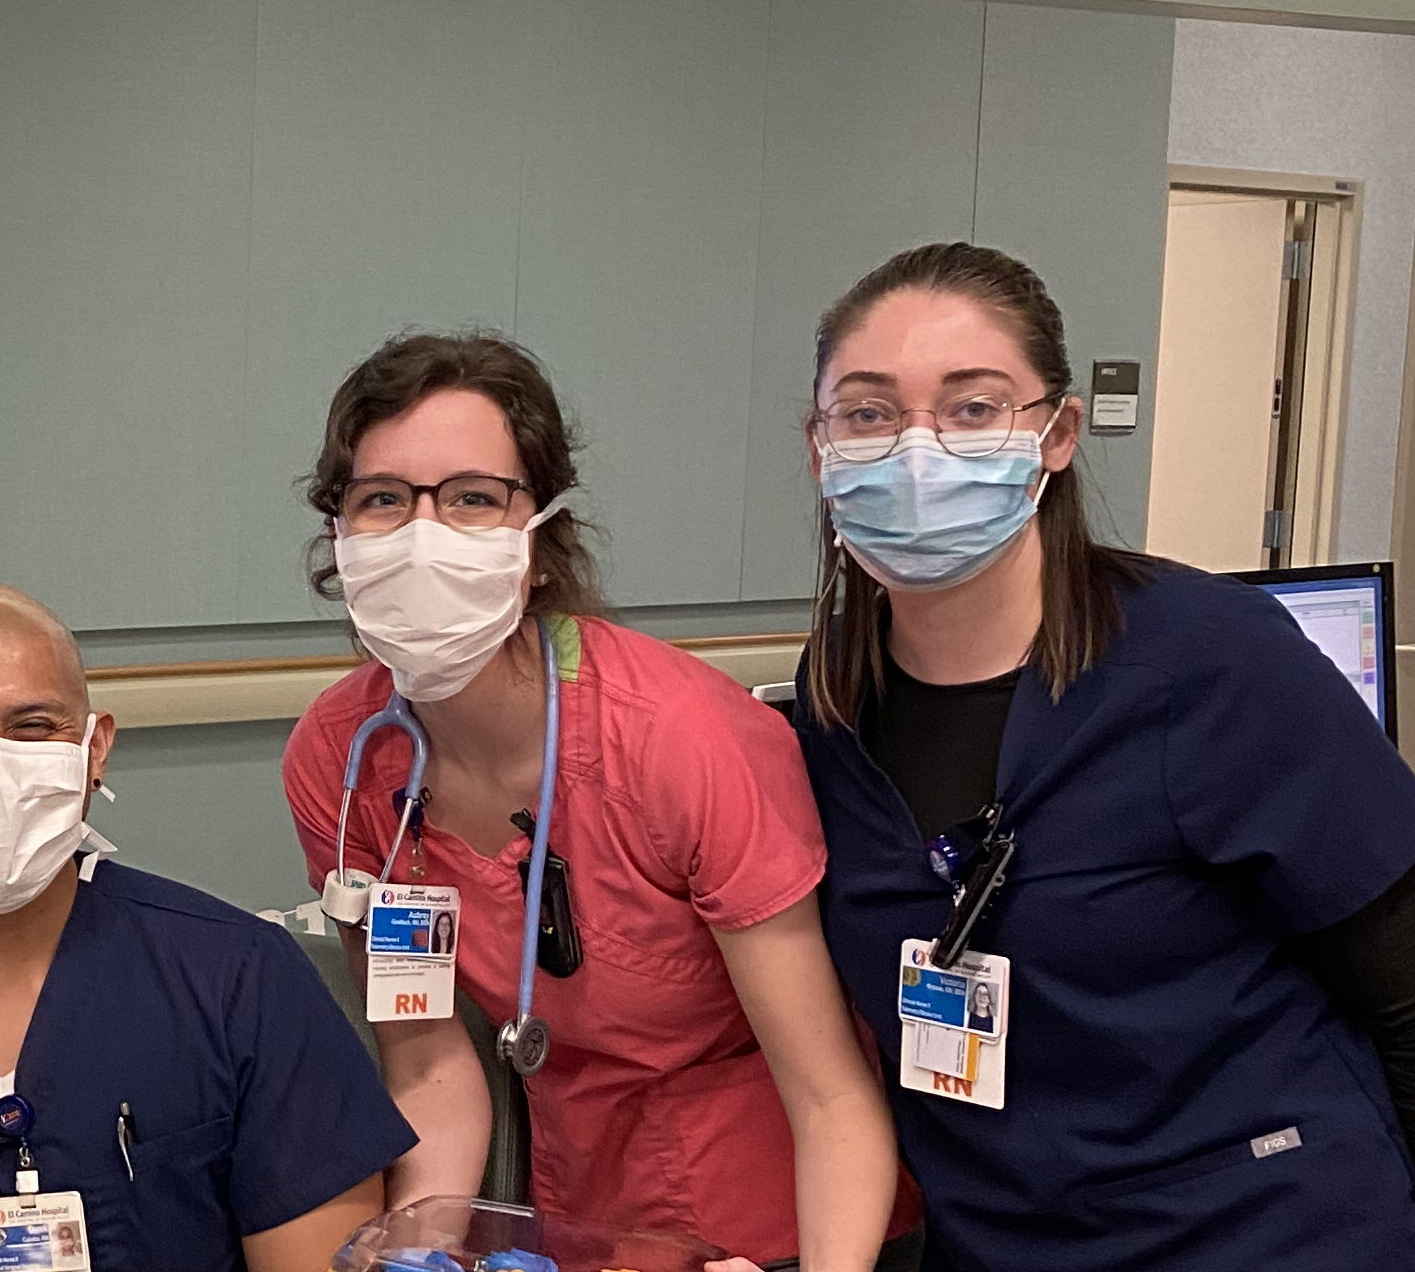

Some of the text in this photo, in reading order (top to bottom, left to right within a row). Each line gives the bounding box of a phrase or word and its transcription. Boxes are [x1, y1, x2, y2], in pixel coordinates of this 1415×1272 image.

[394, 992, 428, 1015] RN
[933, 1071, 974, 1098] RN
[1264, 1136, 1287, 1151] FIGS
[41, 1205, 70, 1216] Hospital
